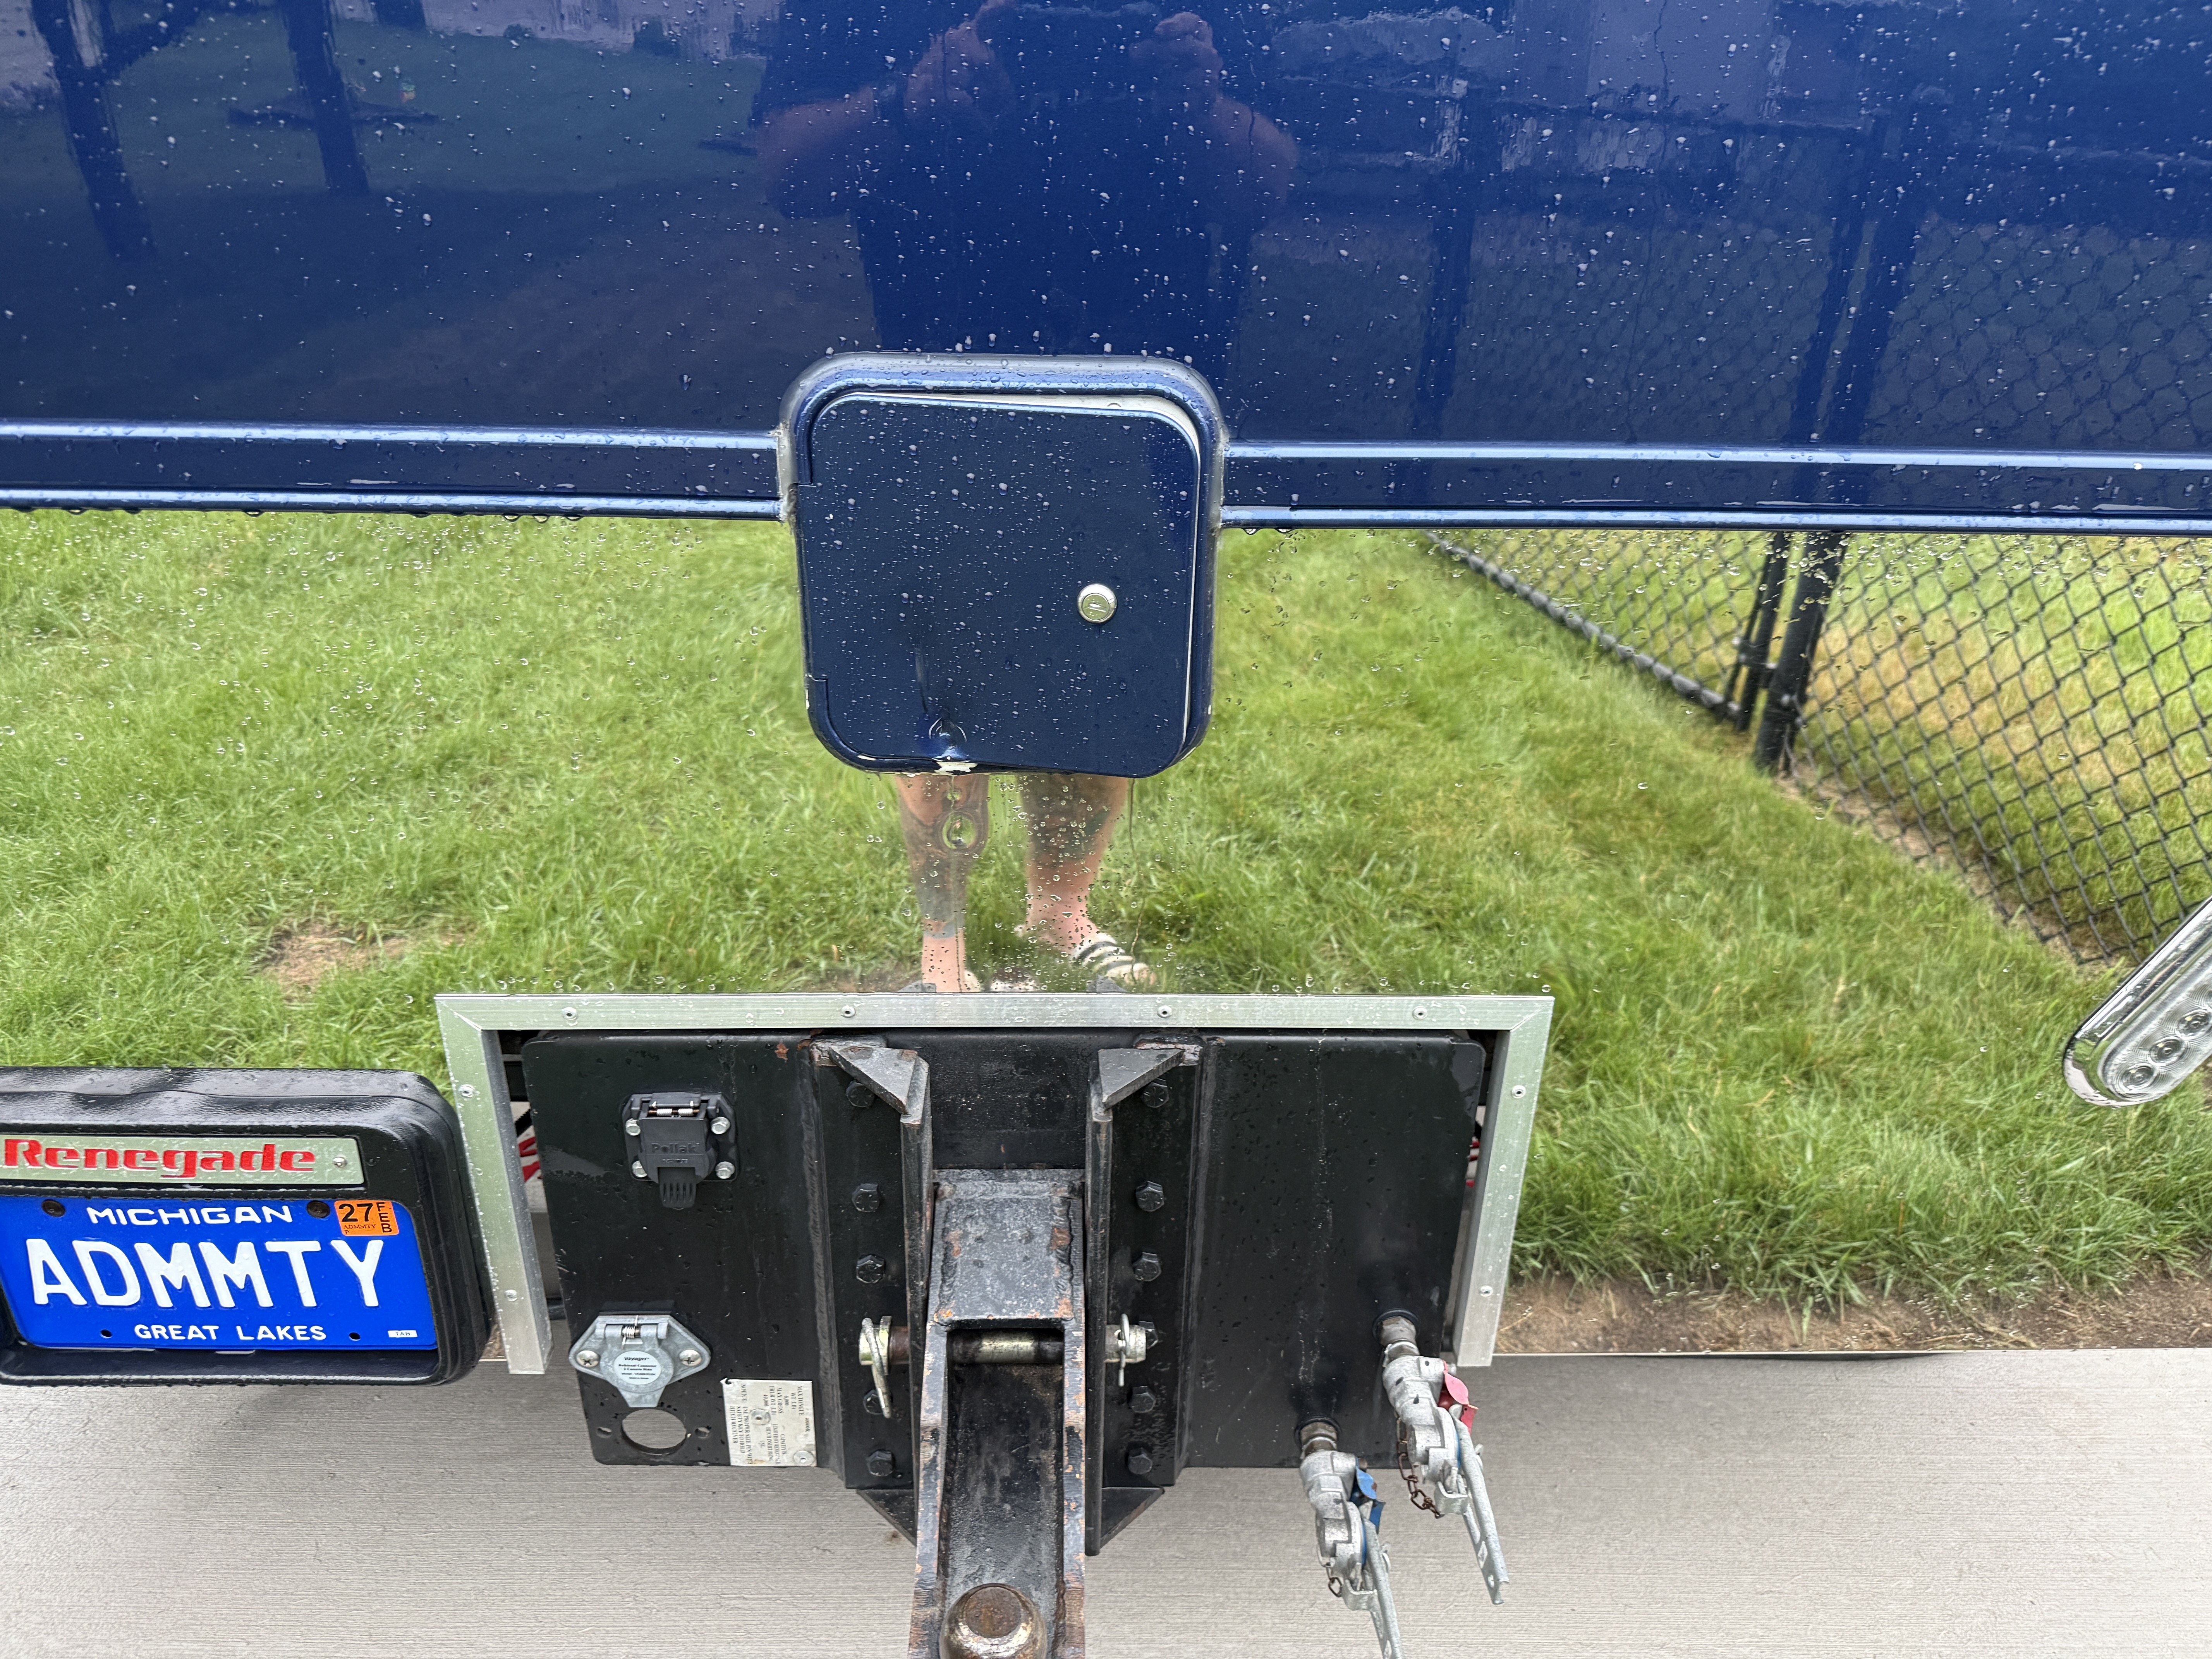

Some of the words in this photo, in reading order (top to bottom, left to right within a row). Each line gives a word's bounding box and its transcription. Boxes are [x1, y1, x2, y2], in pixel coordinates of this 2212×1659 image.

[651, 1143, 700, 1153] Pollak
[4, 1139, 315, 1179] Renegade
[86, 1206, 293, 1225] MICHIGAN
[338, 1203, 373, 1222] 27
[376, 1202, 392, 1233] FEB
[26, 1238, 384, 1307] ADMMTY
[135, 1324, 219, 1340] GREAT
[238, 1325, 326, 1341] LAKES
